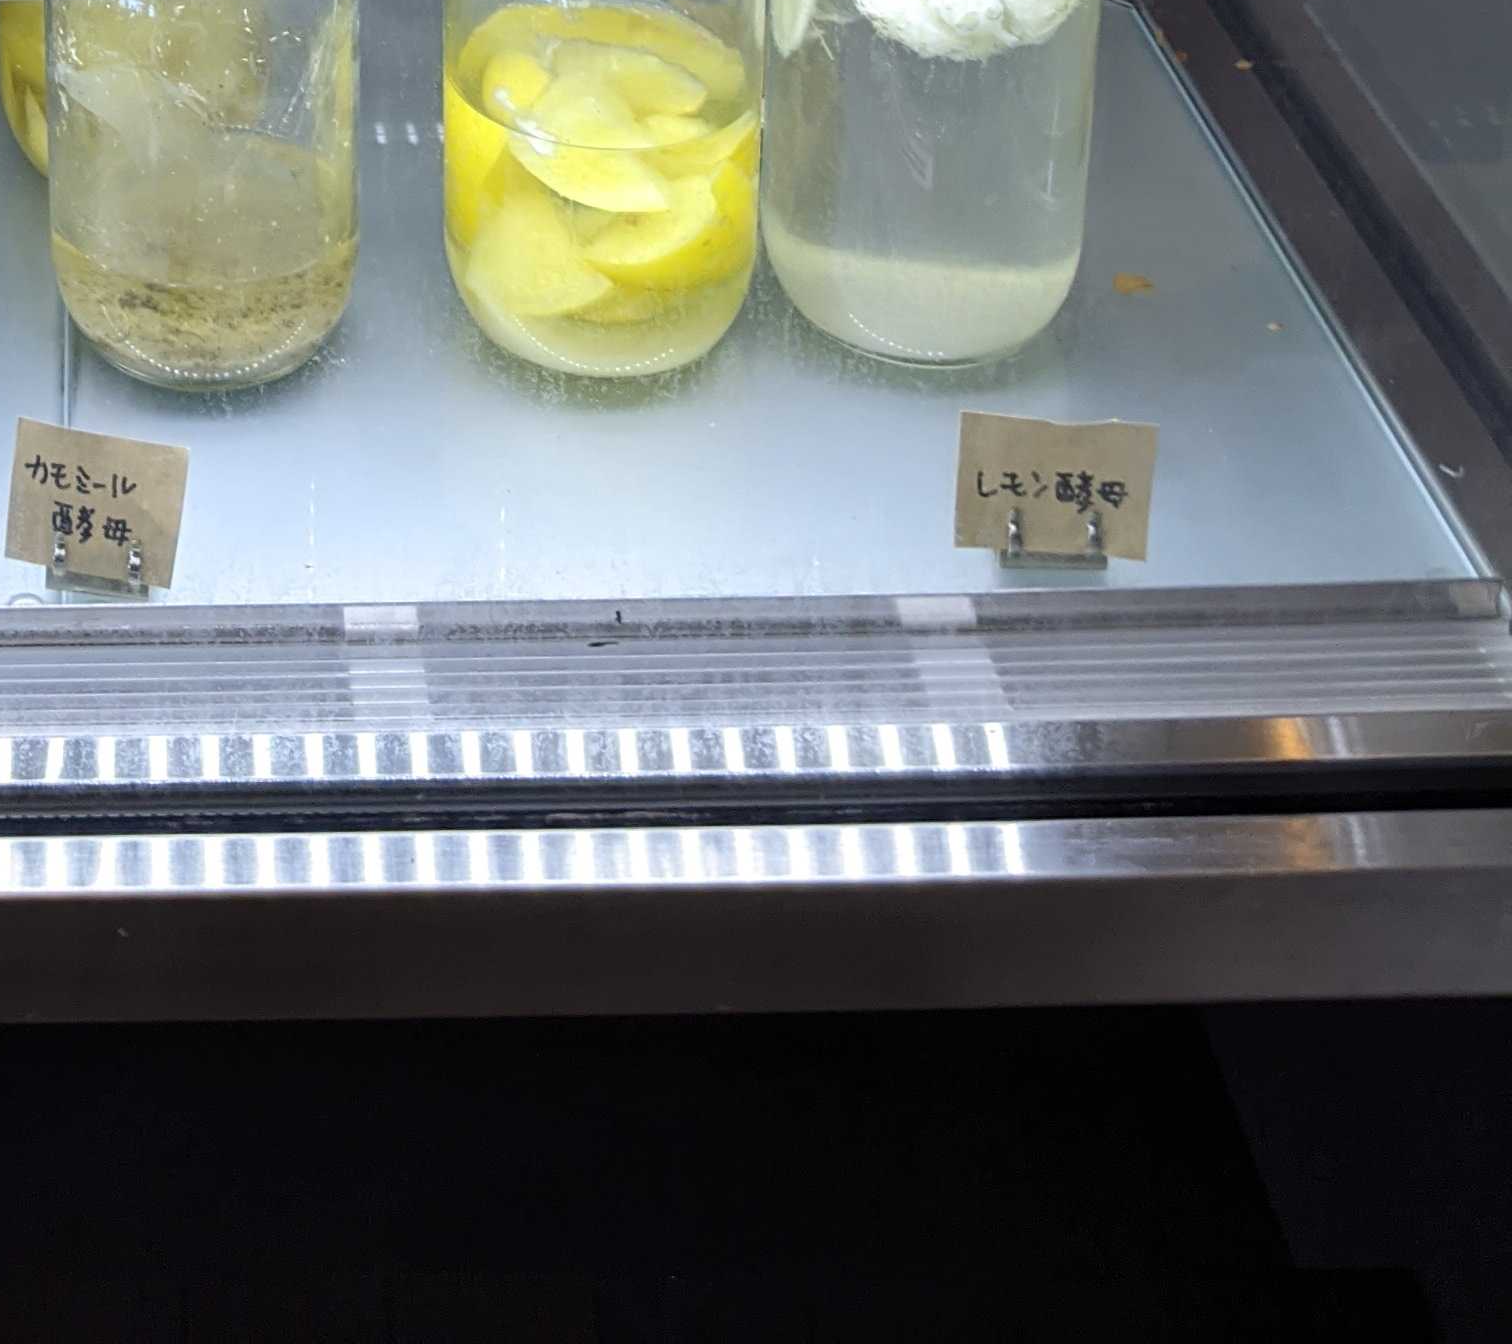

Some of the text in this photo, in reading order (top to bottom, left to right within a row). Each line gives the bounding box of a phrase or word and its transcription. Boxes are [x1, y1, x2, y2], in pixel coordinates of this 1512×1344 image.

[25, 455, 137, 498] カモミール
[977, 470, 1128, 515] レモン酵母
[52, 501, 132, 546] 酵母
